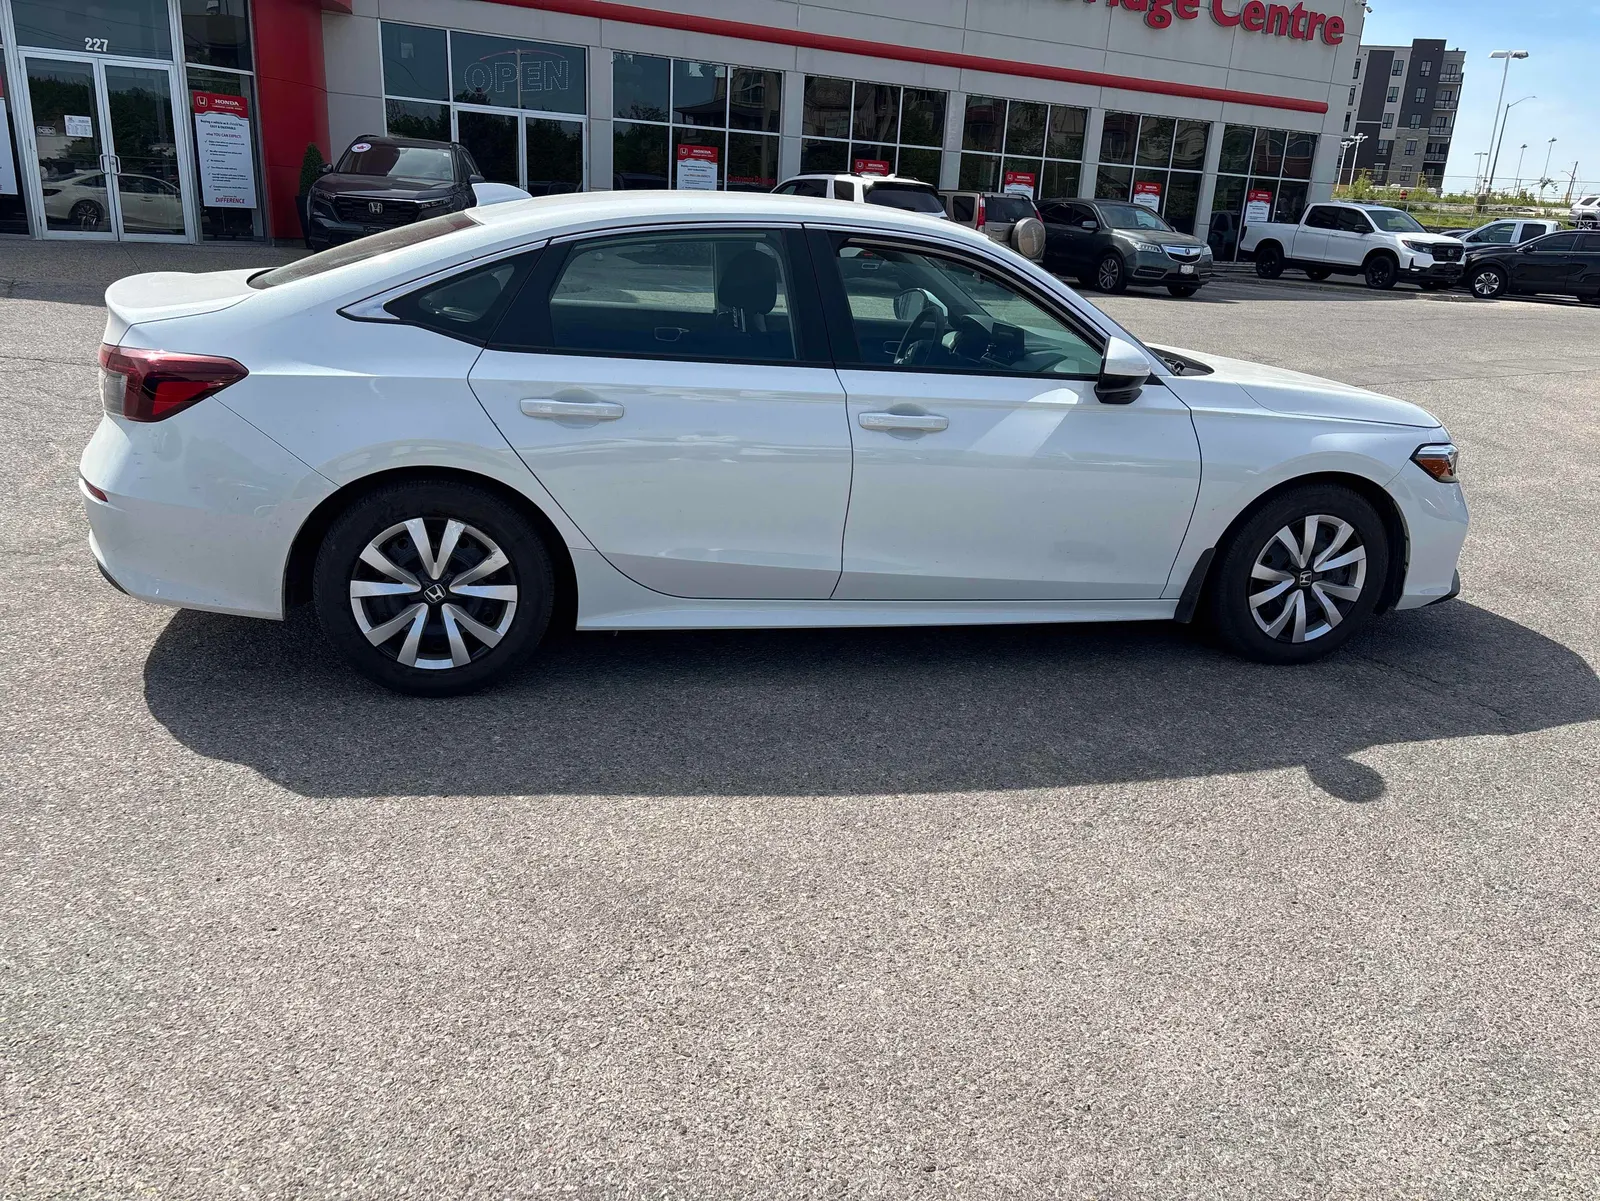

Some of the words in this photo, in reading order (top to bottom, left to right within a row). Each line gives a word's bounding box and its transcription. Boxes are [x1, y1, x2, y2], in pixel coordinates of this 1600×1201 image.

[1207, 0, 1345, 46] Centre
[84, 37, 108, 52] 227
[464, 60, 569, 94] OPEN
